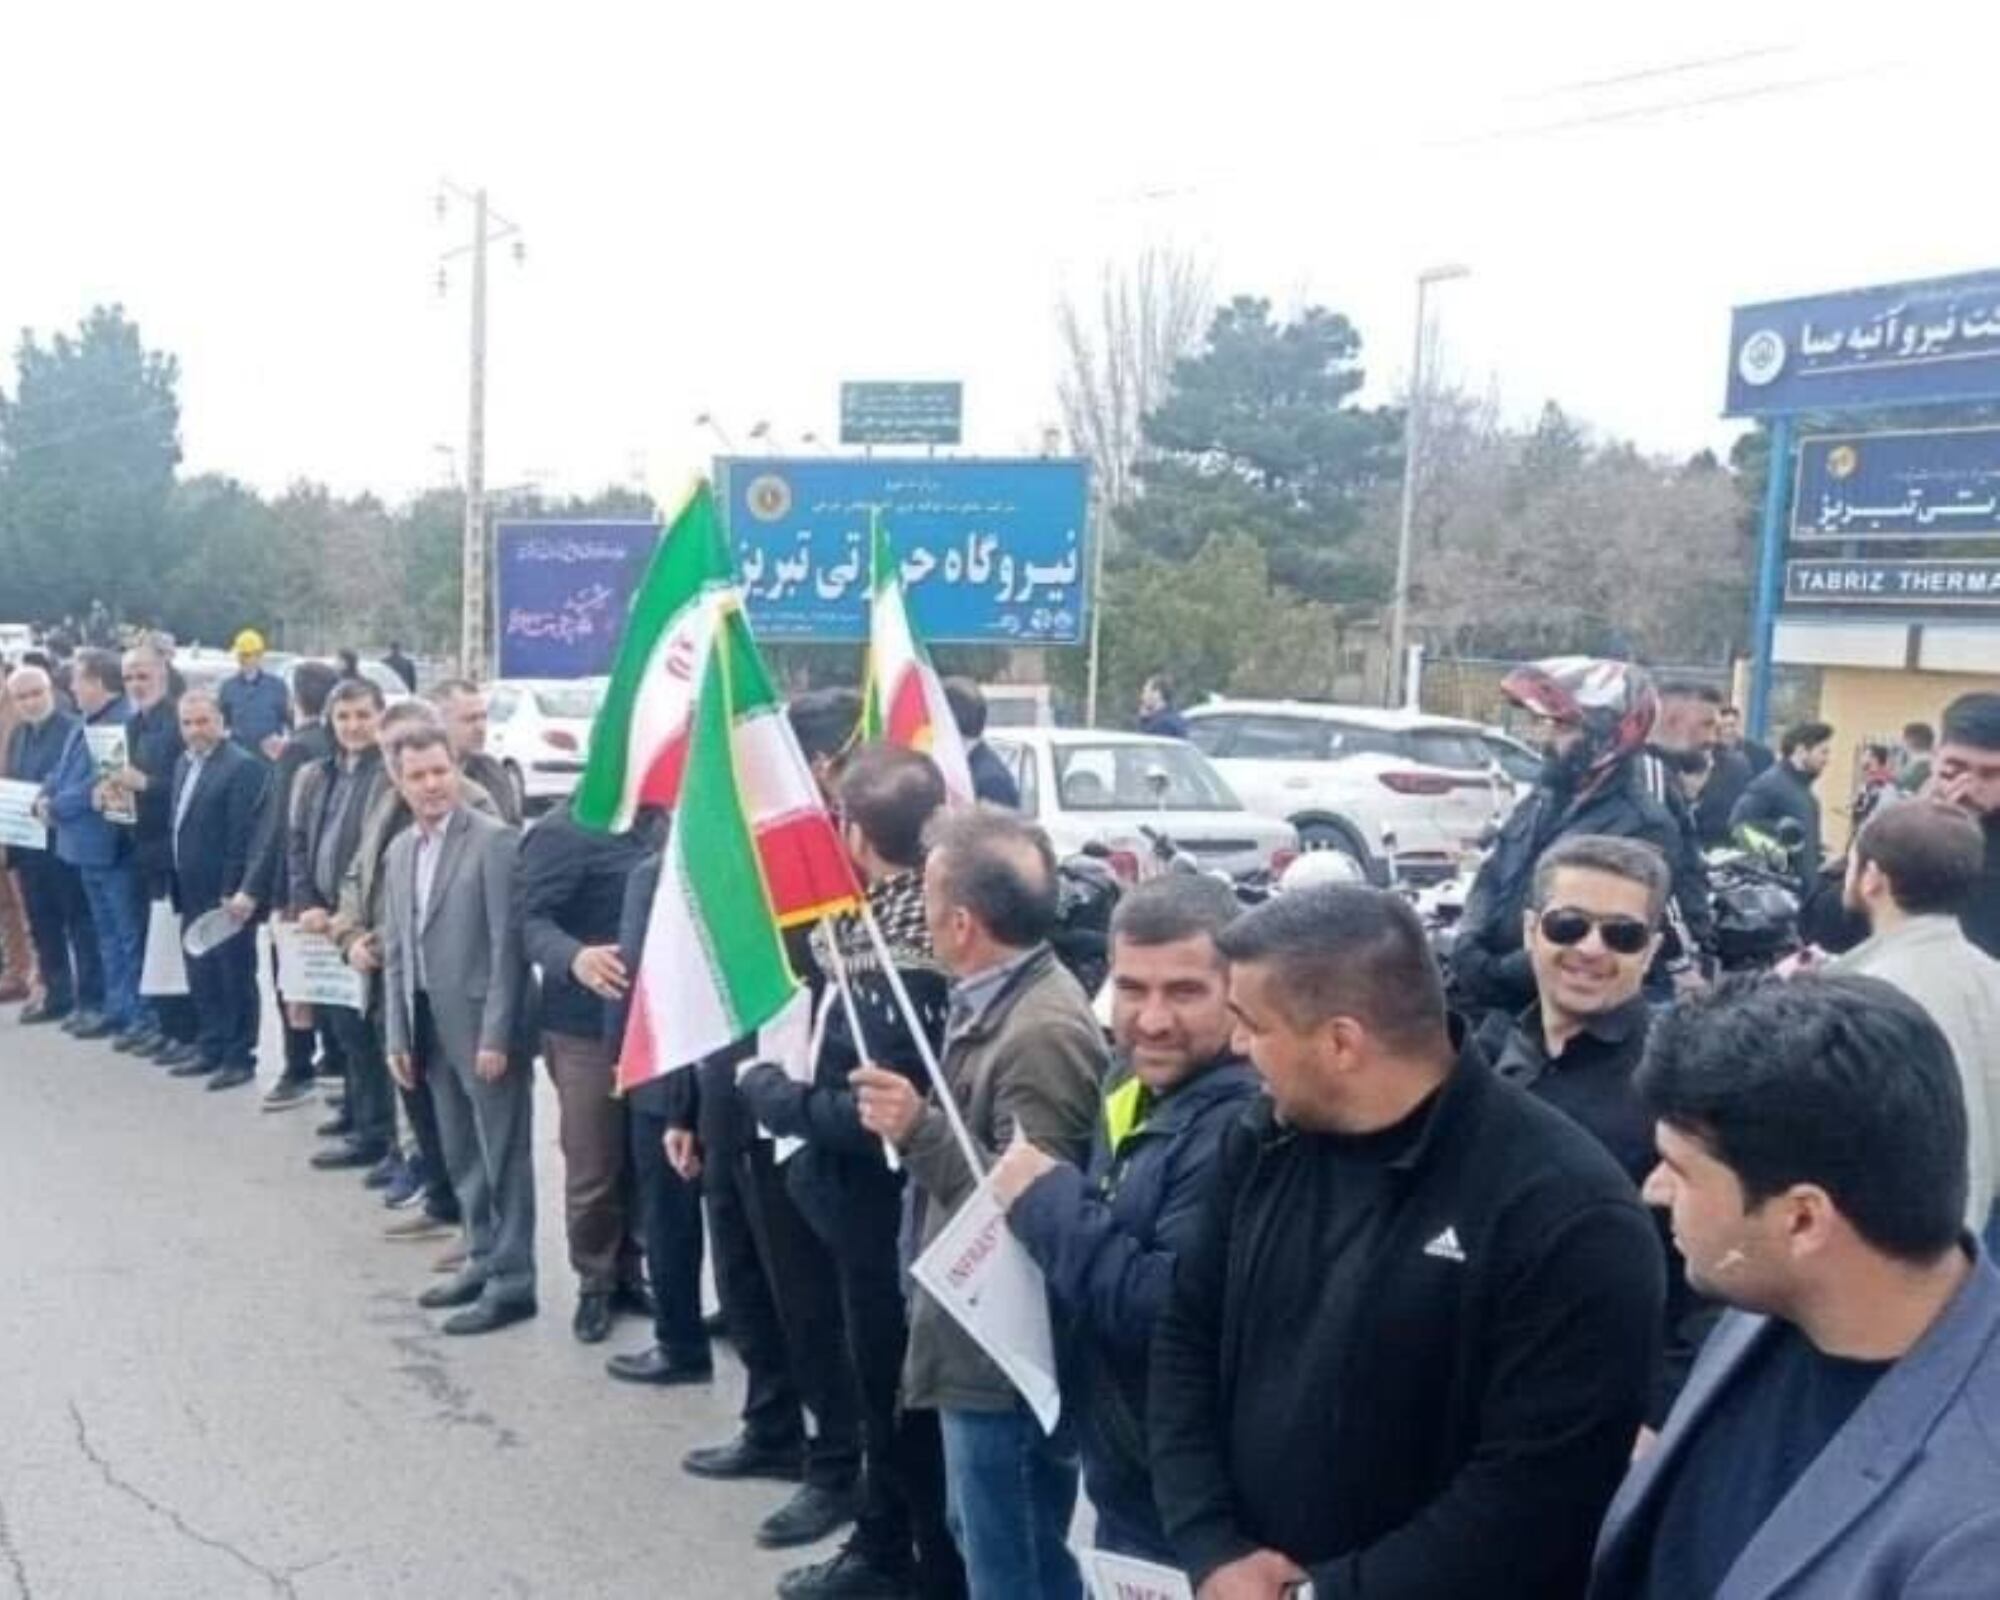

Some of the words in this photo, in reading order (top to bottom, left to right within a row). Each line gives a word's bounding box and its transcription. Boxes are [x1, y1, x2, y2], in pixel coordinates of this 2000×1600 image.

[1818, 489, 1923, 532] تبریز
[738, 528, 813, 600] تبریز
[944, 529, 1076, 602] نیروگاه
[1797, 570, 1886, 591] TABRIZ
[1898, 570, 2000, 593] THERMA
